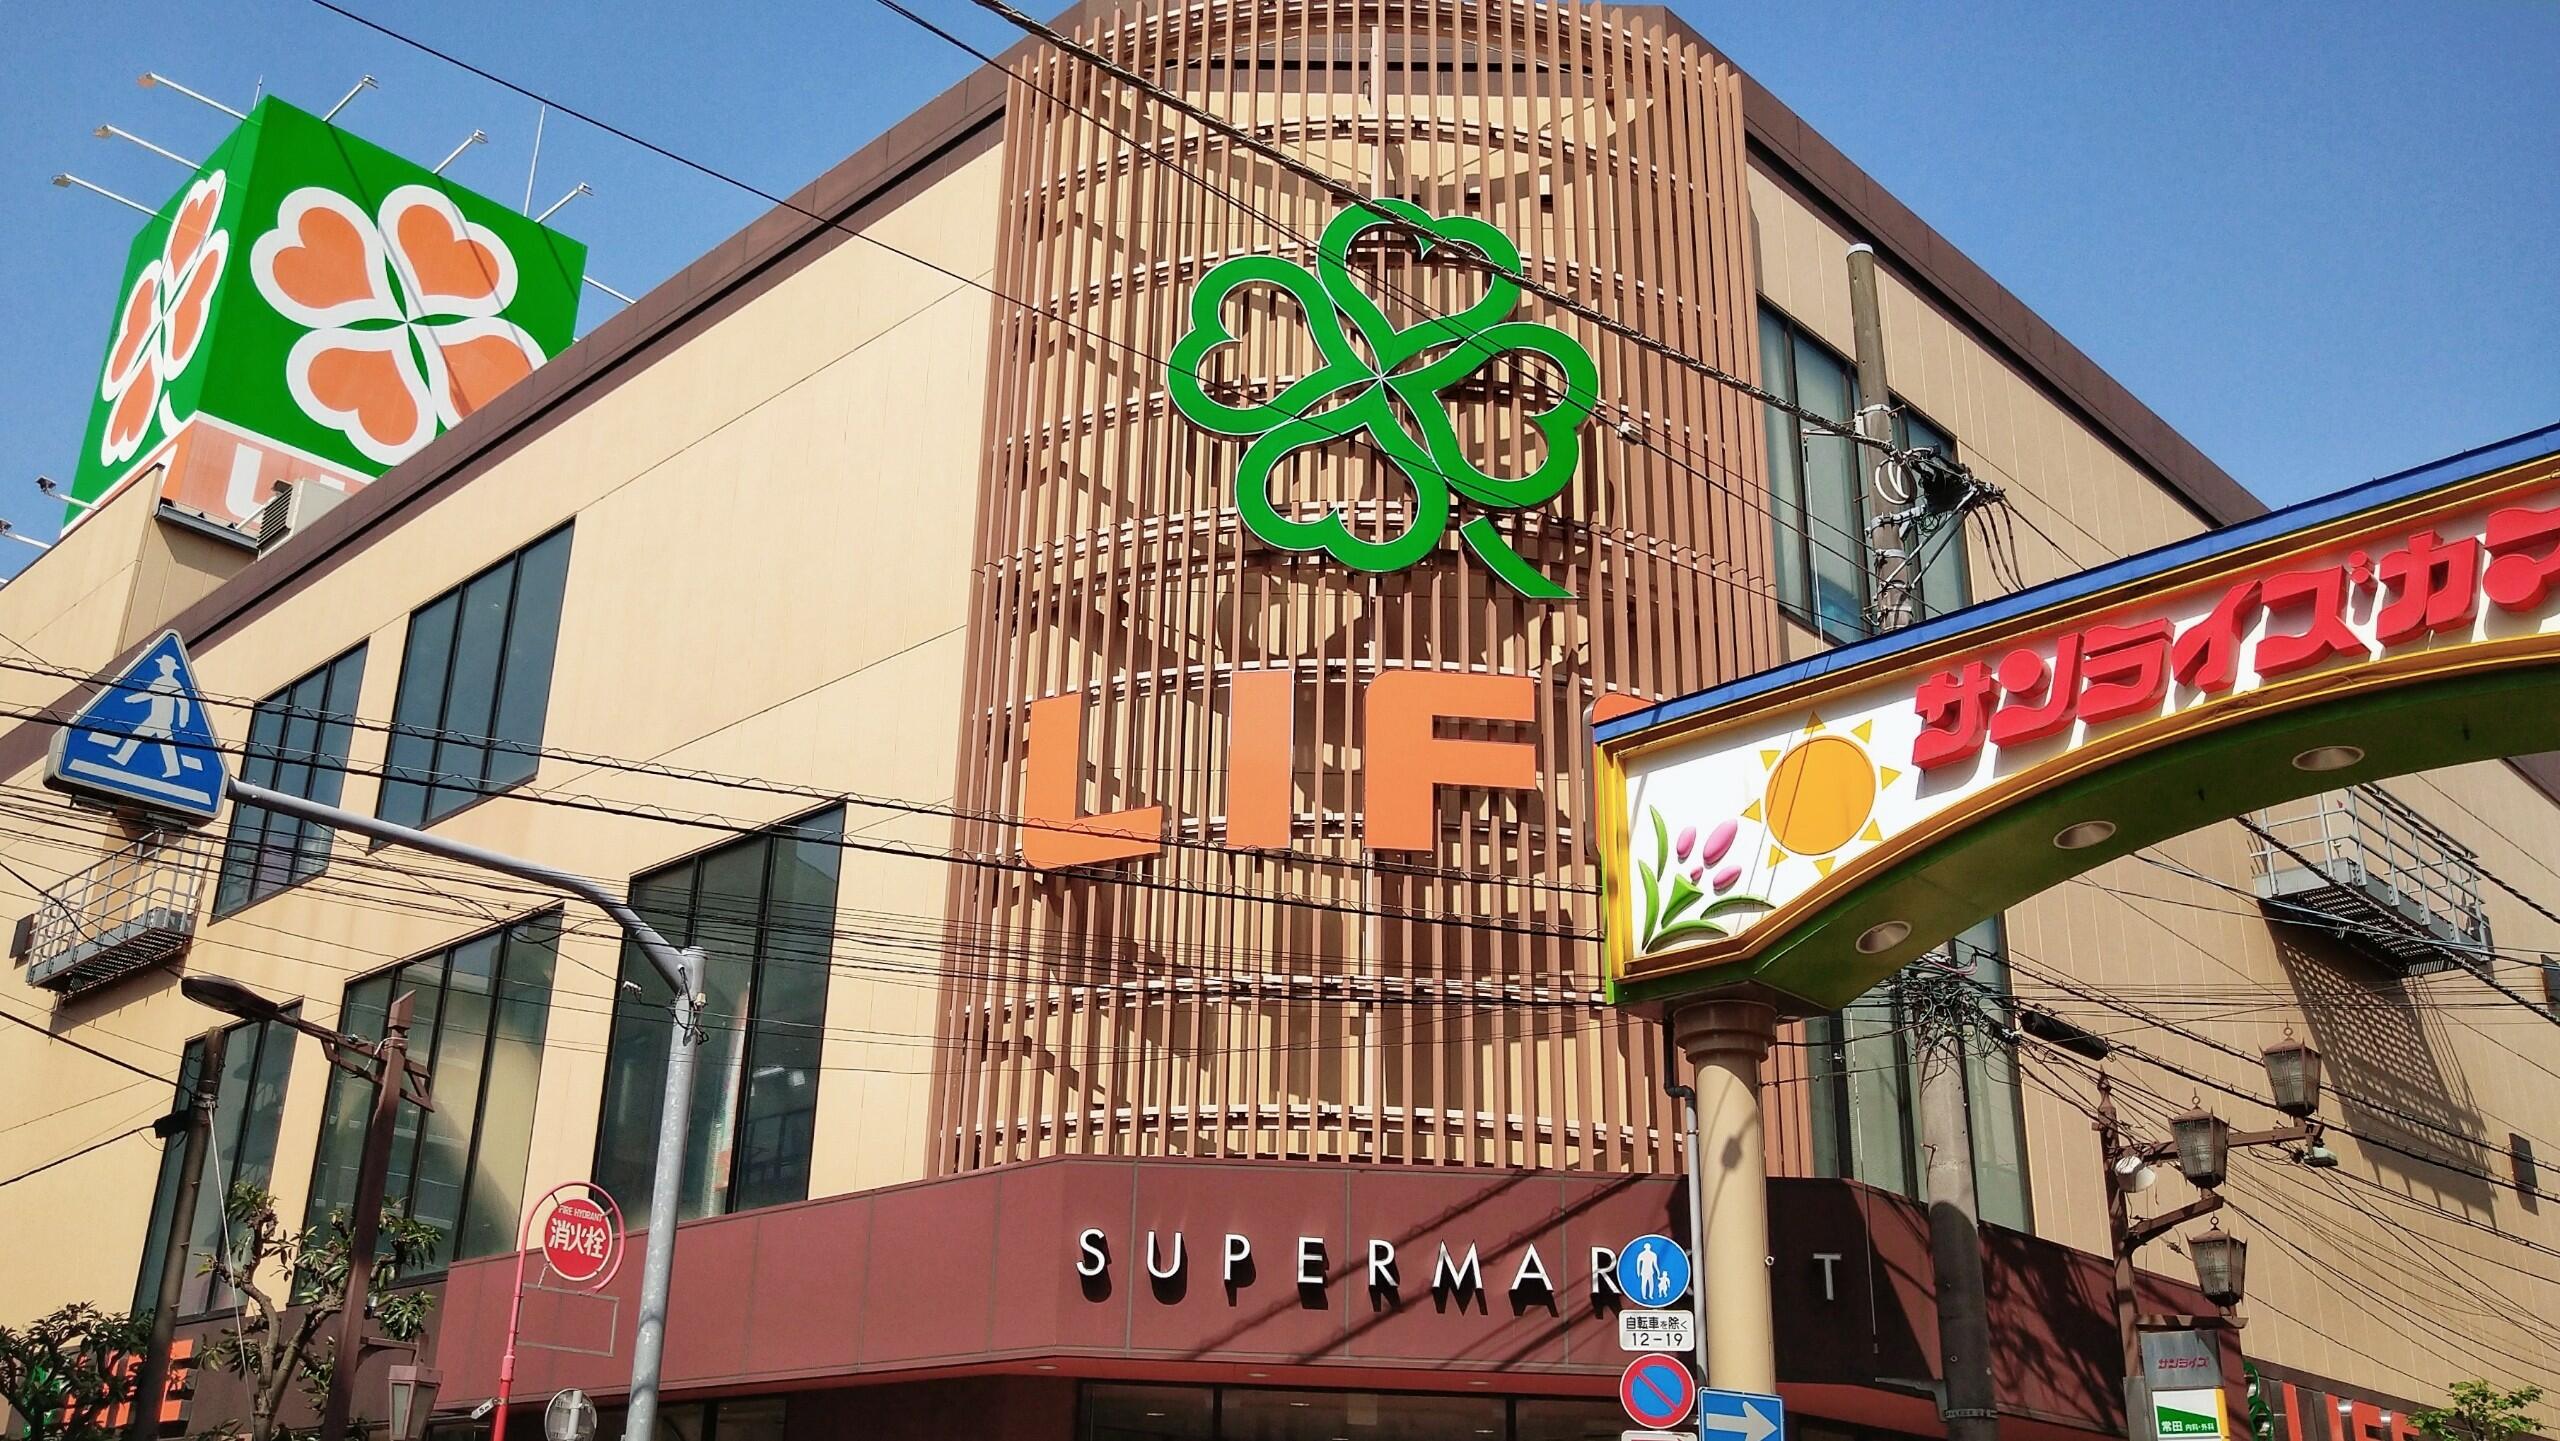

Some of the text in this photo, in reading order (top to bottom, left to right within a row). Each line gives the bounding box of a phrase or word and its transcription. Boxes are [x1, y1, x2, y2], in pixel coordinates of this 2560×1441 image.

[1022, 670, 1662, 869] LIF
[559, 1205, 573, 1216] FIRE
[548, 1217, 606, 1259] 消火栓
[1076, 1227, 1842, 1302] SUPERMART
[1626, 1316, 1688, 1330] 自転車を除く
[1632, 1333, 1682, 1346] 12-19
